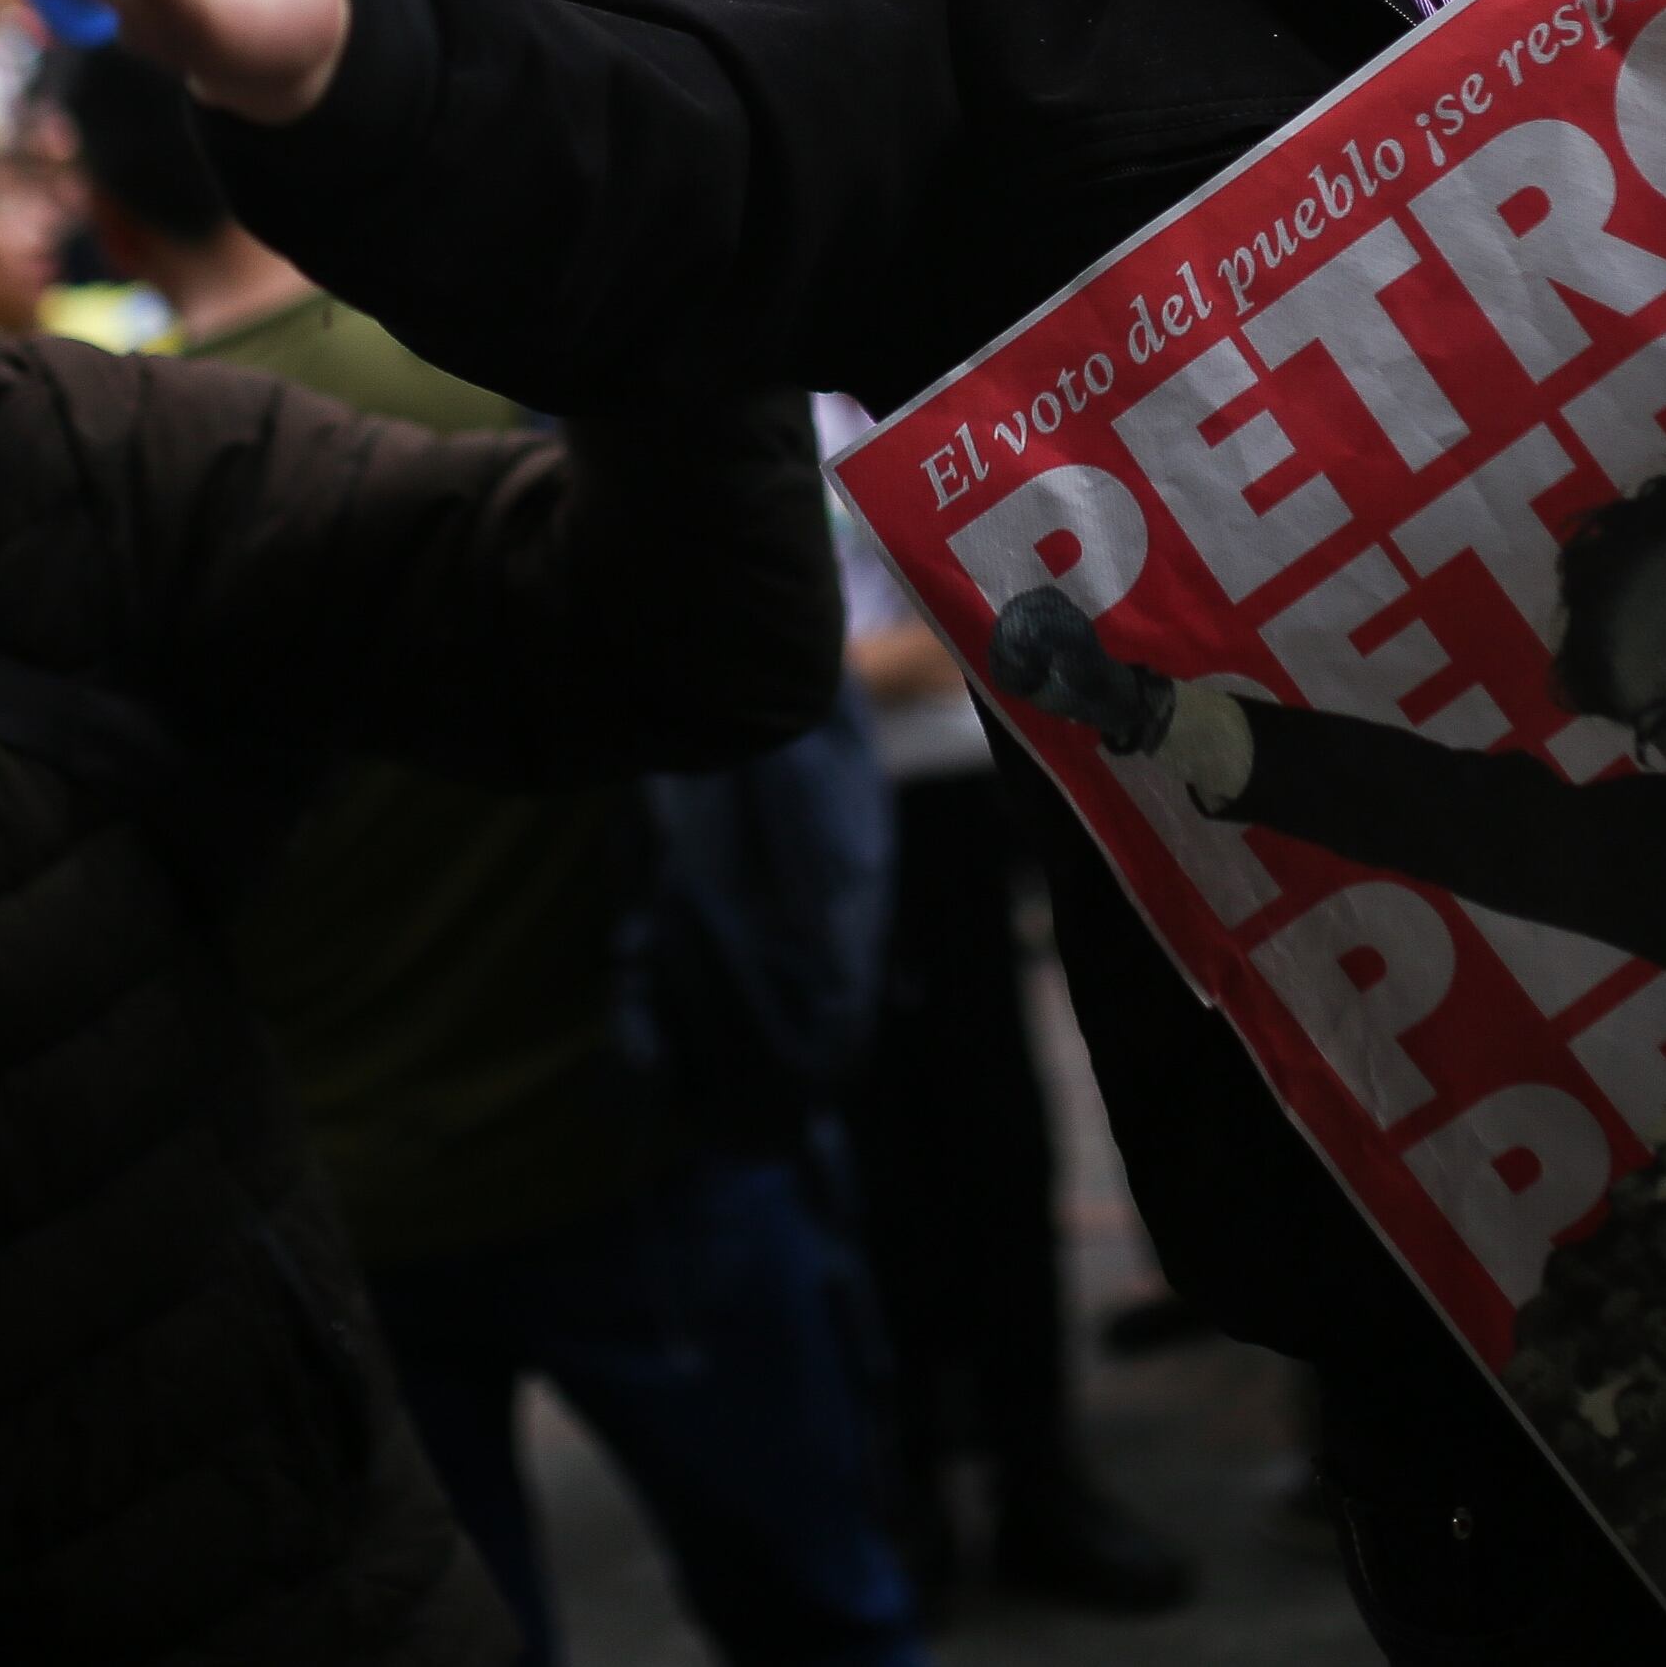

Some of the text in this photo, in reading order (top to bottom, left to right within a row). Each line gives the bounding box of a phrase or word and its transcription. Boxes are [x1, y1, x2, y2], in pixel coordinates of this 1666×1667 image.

[920, 442, 990, 512] El
[993, 351, 1115, 455] voto
[1128, 263, 1215, 365] del
[1218, 135, 1409, 318] pueblo
[1415, 69, 1493, 167] ¡se
